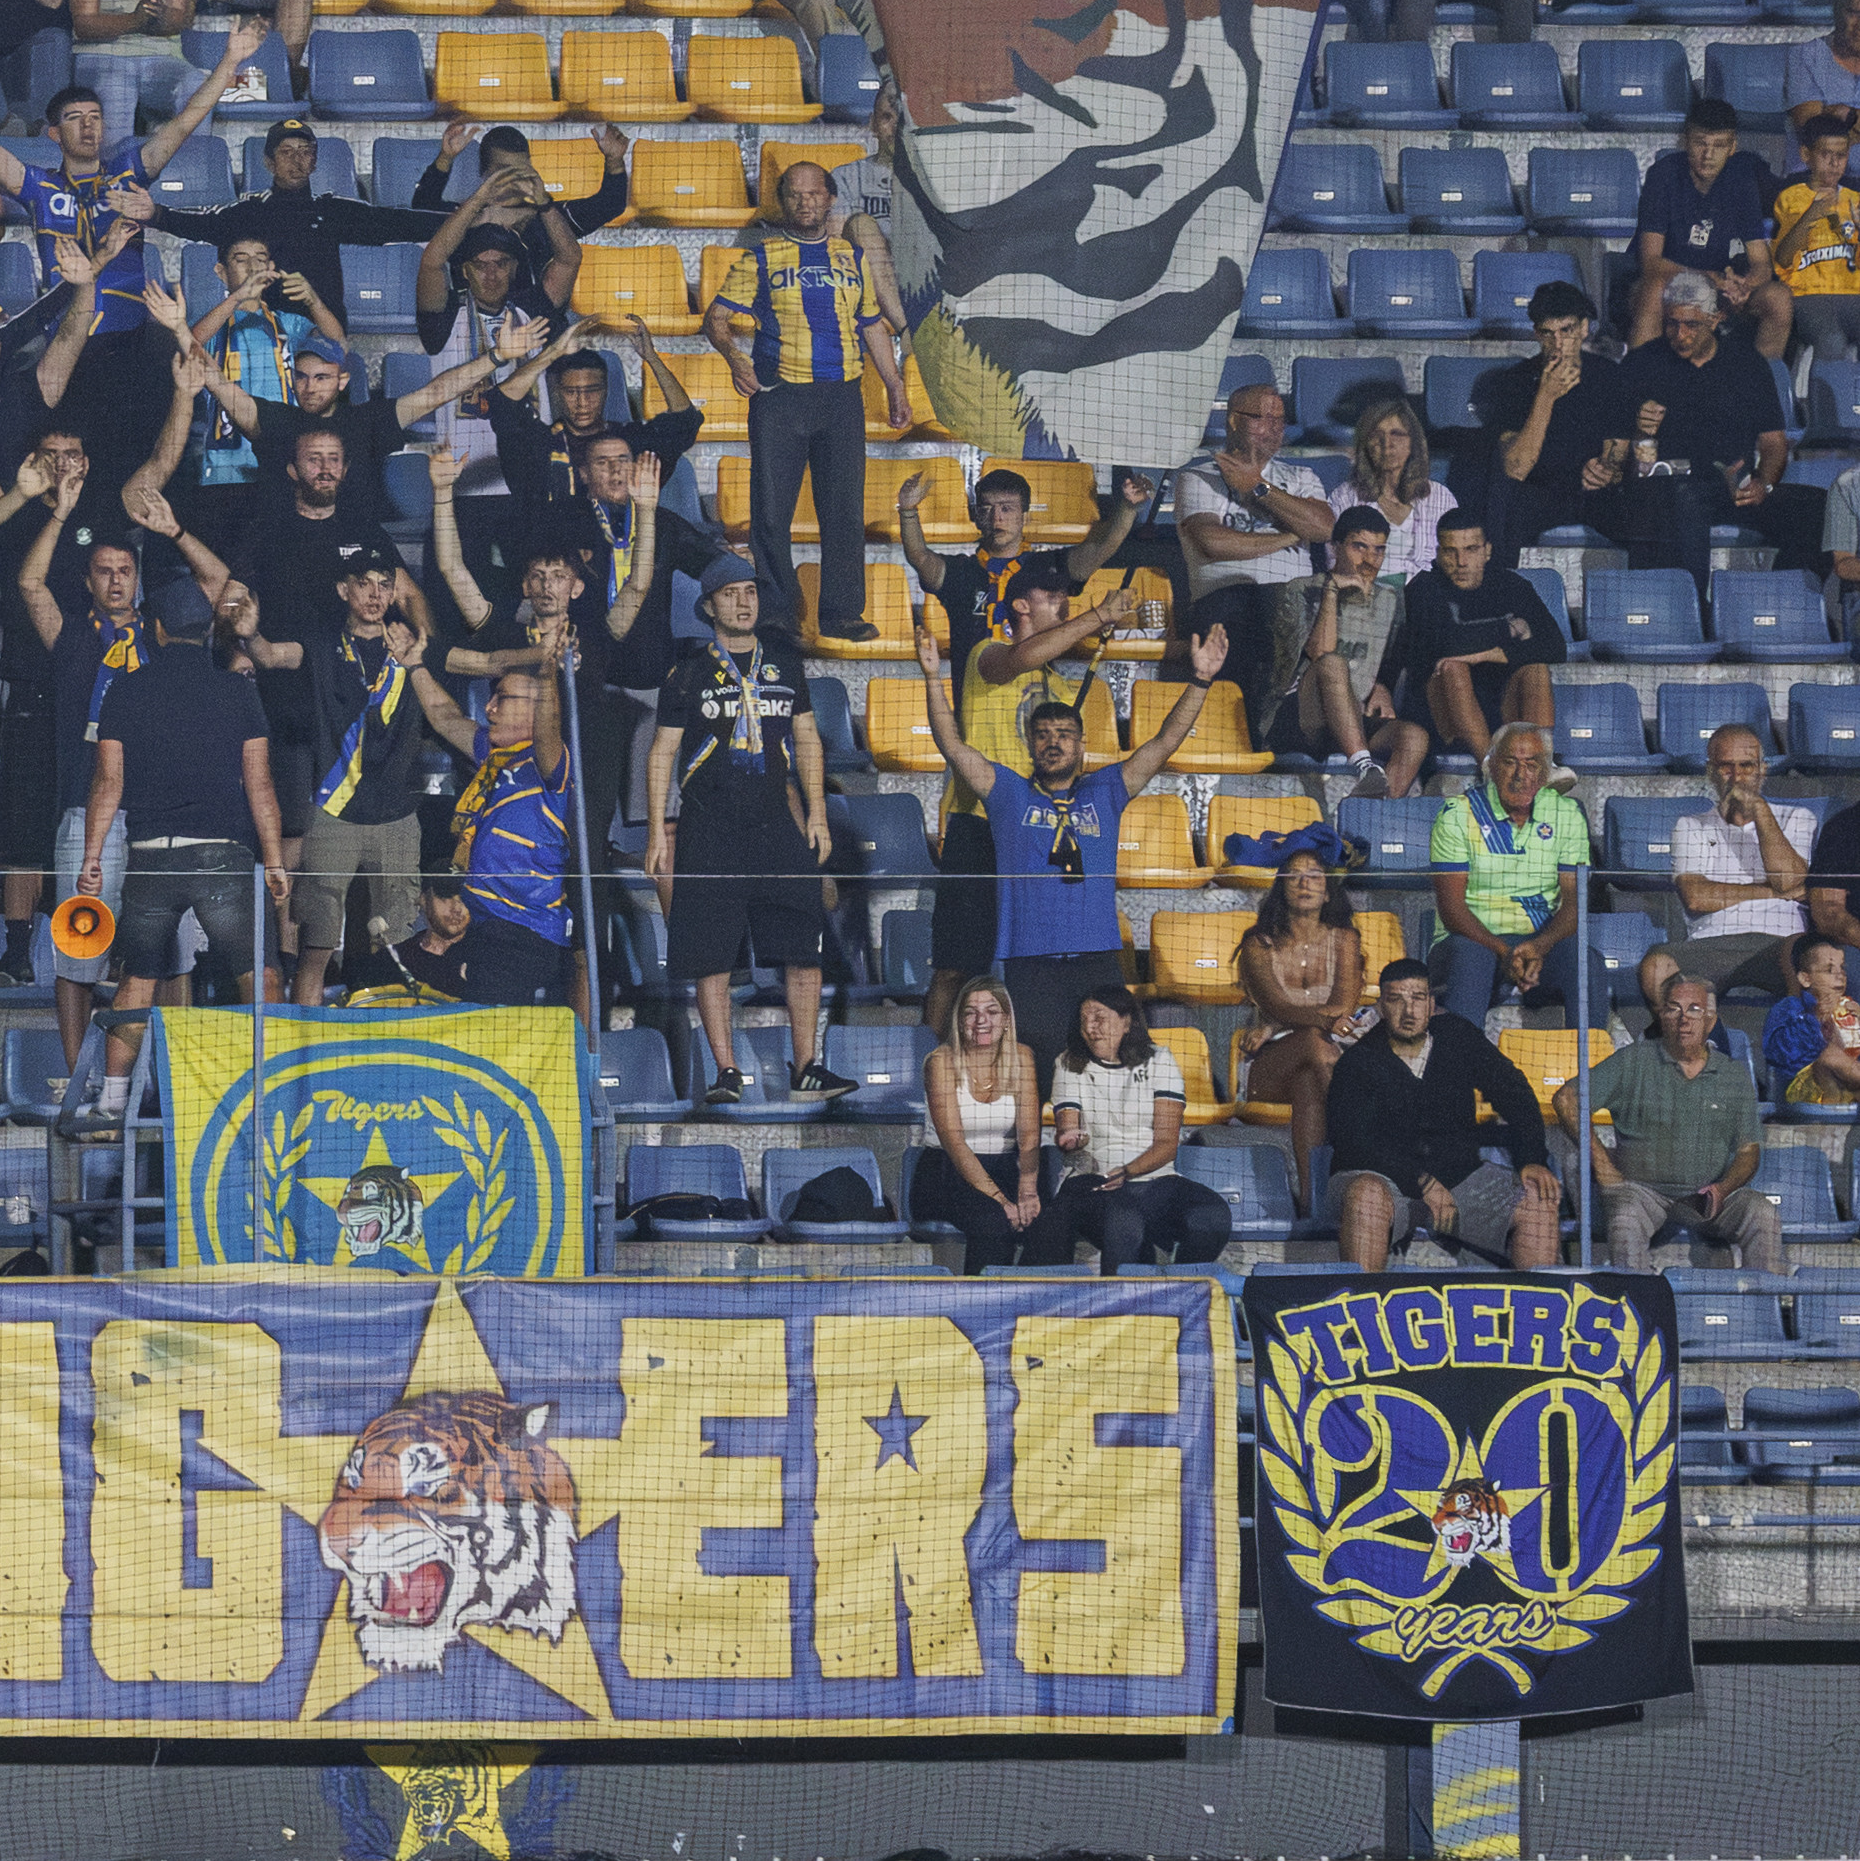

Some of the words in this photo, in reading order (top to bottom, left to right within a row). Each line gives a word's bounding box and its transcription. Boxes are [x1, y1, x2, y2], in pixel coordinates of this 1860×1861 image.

[311, 1089, 424, 1131] Tigers
[1278, 1280, 1640, 1385] TIGERS
[1304, 1375, 1637, 1607] 20
[1392, 1599, 1558, 1663] years
